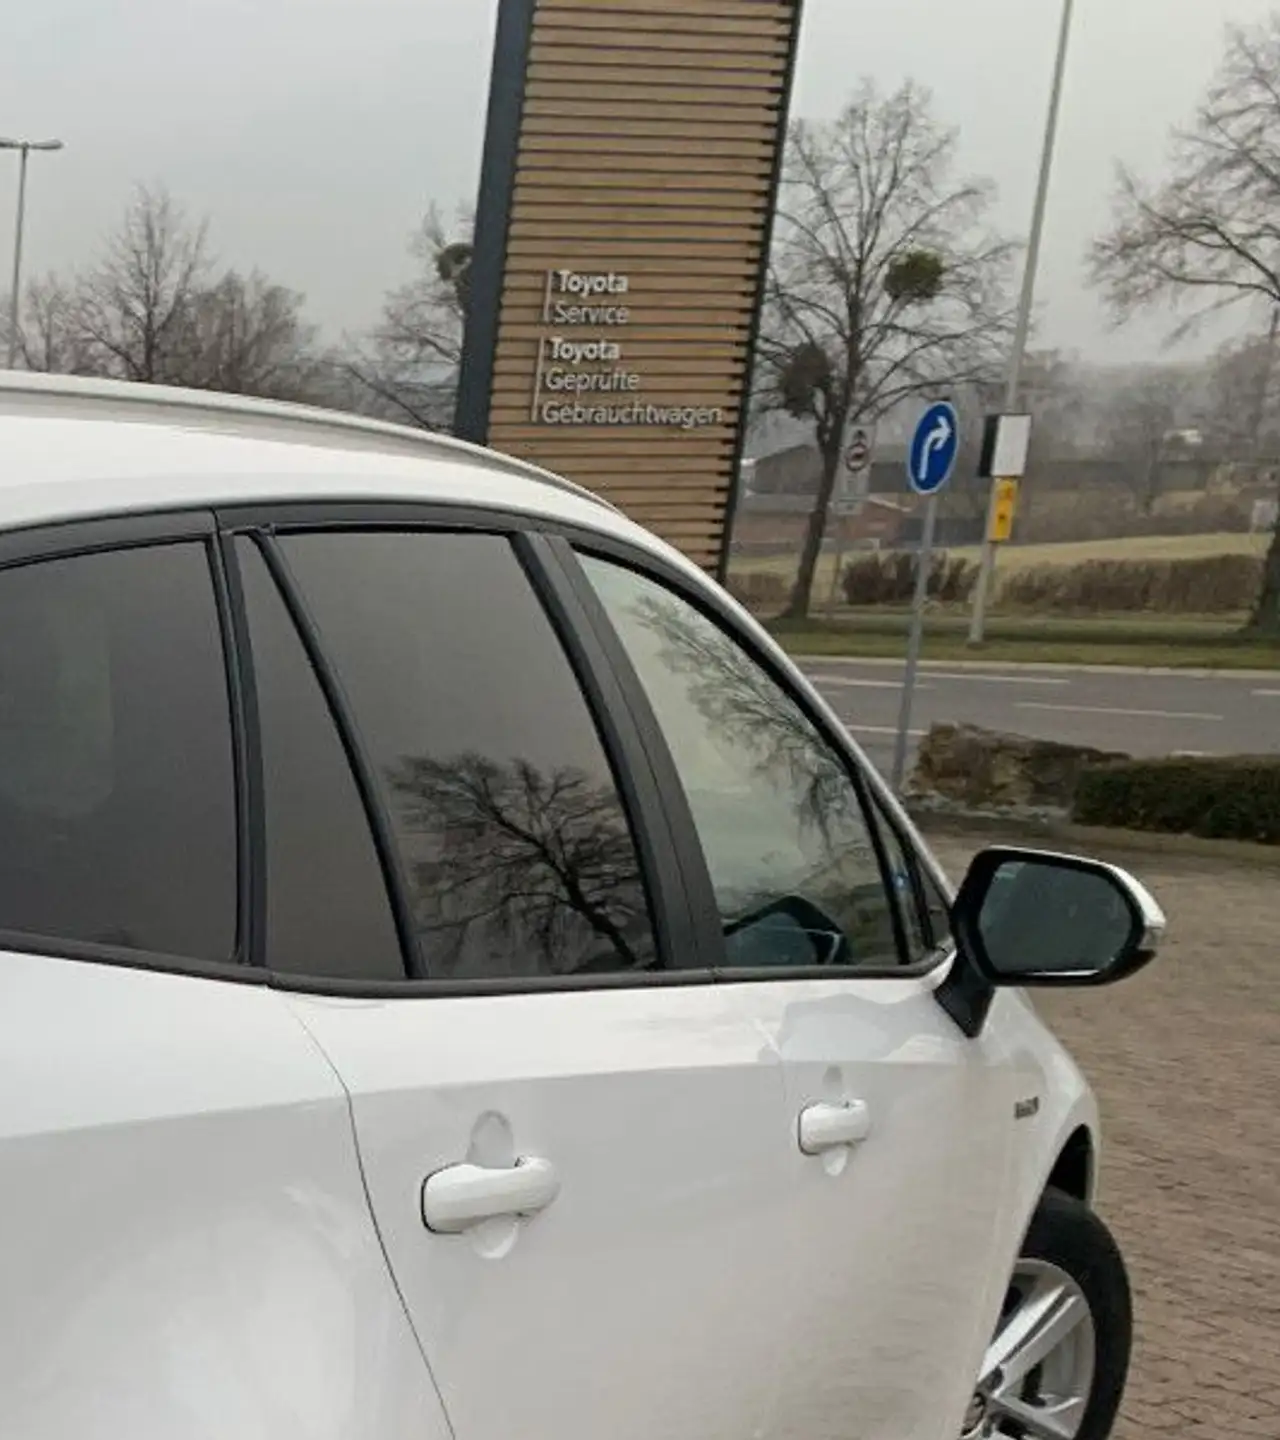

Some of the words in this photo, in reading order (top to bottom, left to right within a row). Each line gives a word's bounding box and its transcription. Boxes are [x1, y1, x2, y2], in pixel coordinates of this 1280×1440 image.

[558, 270, 629, 297] Toyota
[554, 301, 629, 324] Service
[550, 336, 620, 364] Toyota
[545, 368, 640, 398] Geprüfte
[542, 400, 723, 429] Gebrauchtwagen
